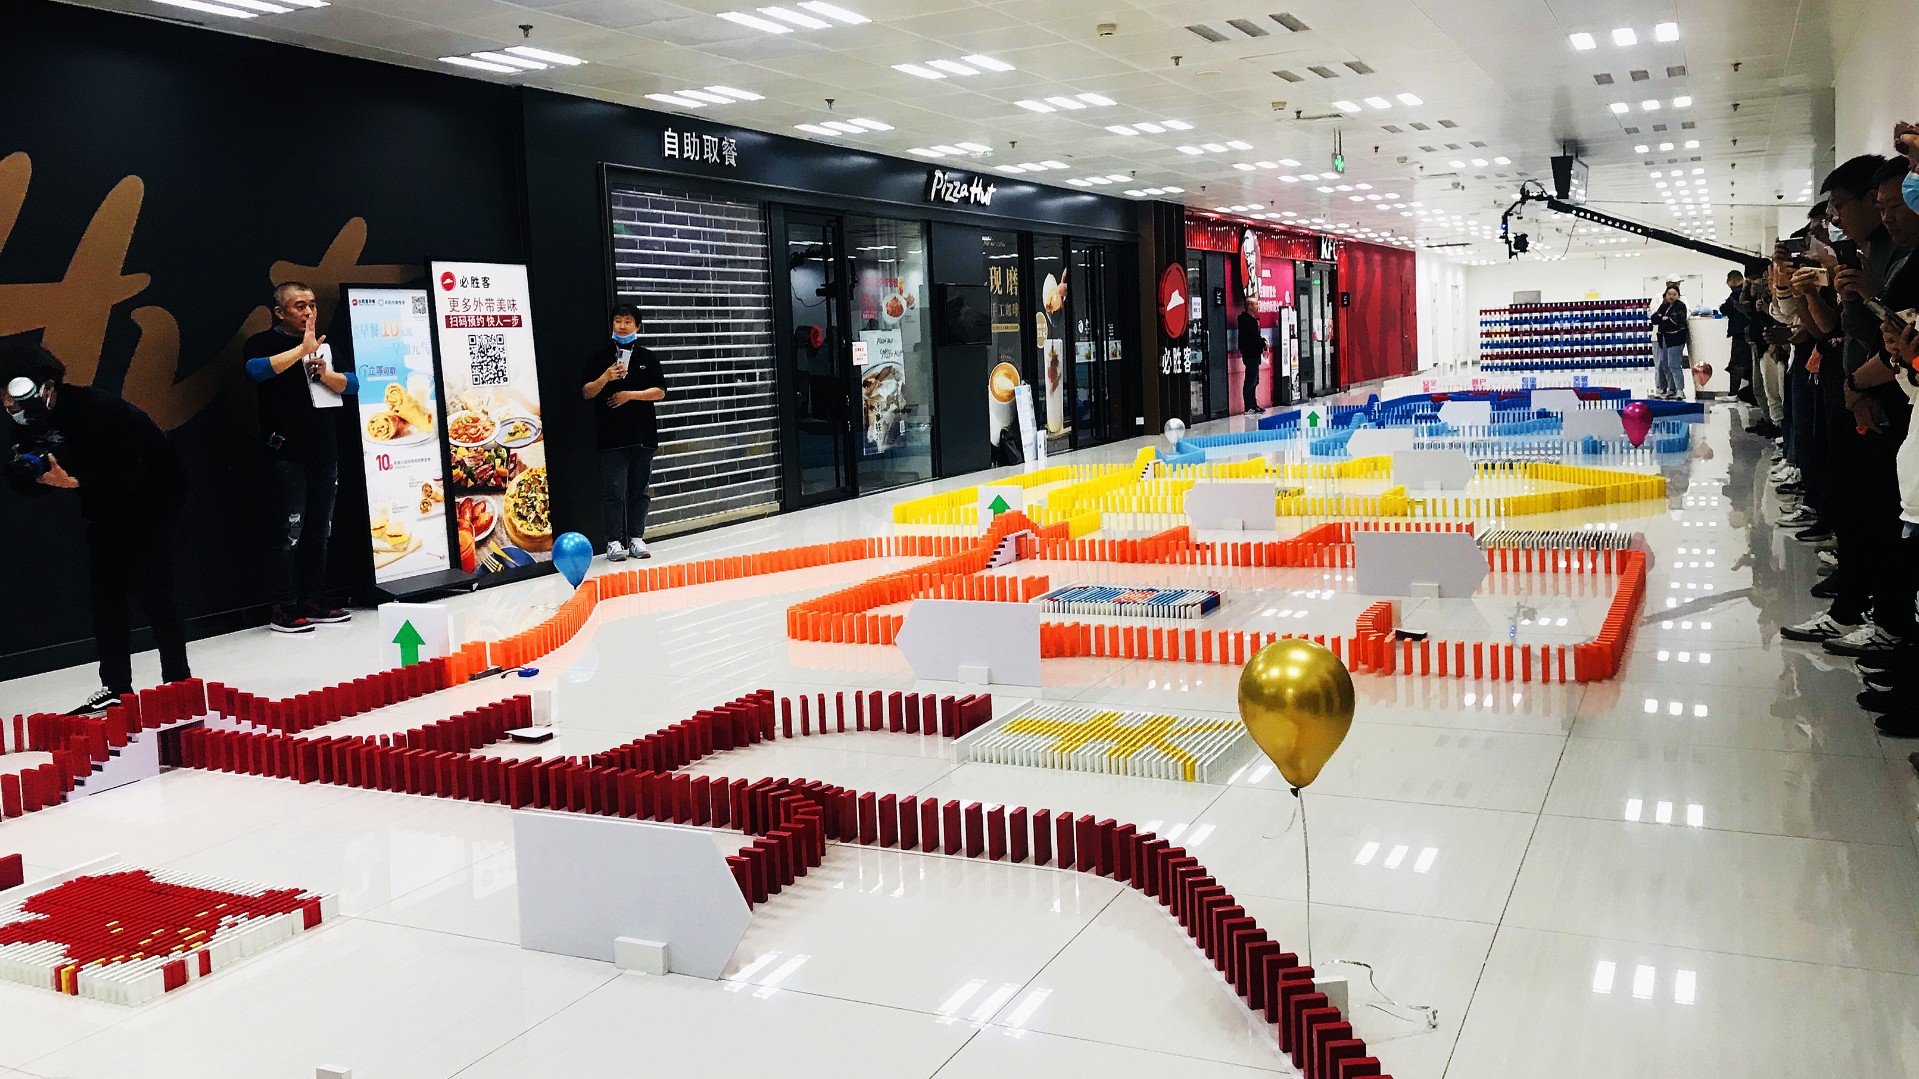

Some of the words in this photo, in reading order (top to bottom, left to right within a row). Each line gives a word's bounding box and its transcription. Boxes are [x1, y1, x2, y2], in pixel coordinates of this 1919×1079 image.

[664, 127, 738, 168] 自助取餐
[930, 169, 969, 203] Pizza
[969, 175, 997, 206] Hut
[459, 276, 491, 289] 必胜客
[447, 296, 518, 313] 更多外带美味
[449, 315, 485, 328] 扫码预约
[486, 315, 520, 328] 快人一步
[1162, 345, 1192, 375] 必胜客
